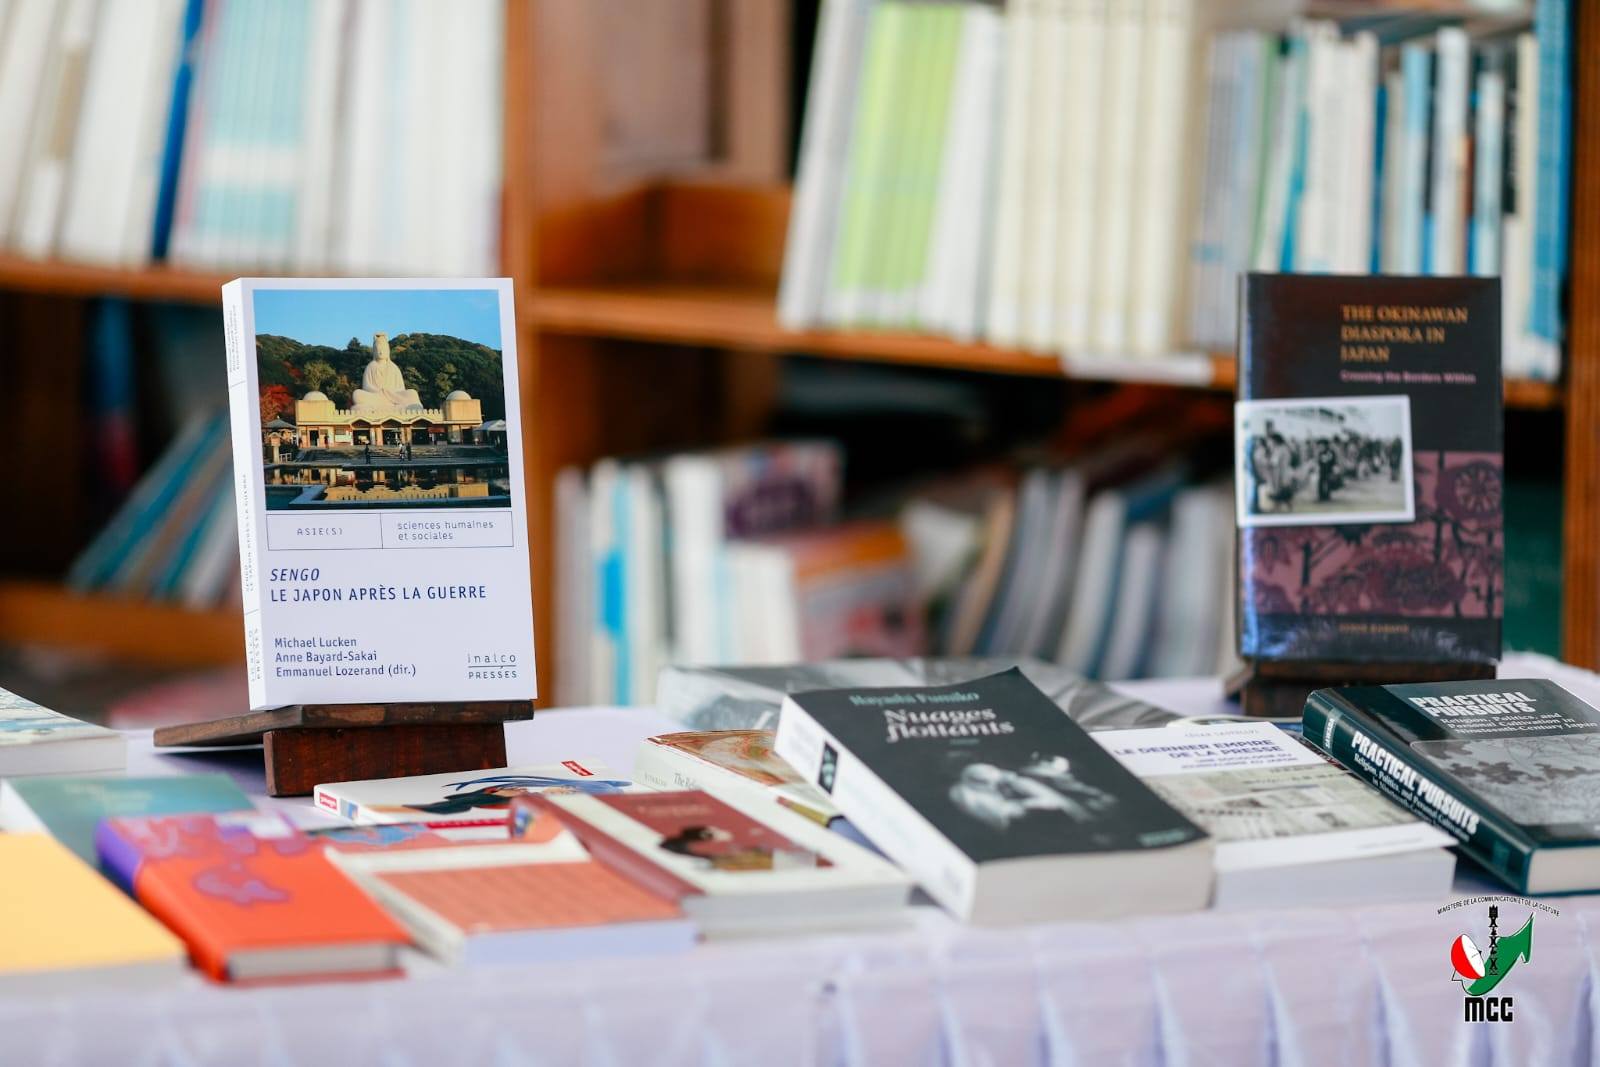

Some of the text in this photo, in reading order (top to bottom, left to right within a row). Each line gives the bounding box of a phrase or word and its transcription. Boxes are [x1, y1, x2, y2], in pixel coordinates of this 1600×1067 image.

[1341, 304, 1468, 323] THE OKINAWAN
[1341, 325, 1445, 343] DIASPORA IN
[1340, 345, 1390, 362] JAPAN
[297, 527, 343, 536] ASIE(S)
[398, 520, 494, 531] sciences humaines
[398, 531, 453, 541] et sociales
[270, 568, 320, 582] SENGO
[271, 584, 487, 602] LE JAPON APRÈS LA GUERRE
[275, 637, 357, 648] Michael Lucken
[275, 650, 377, 665] Anne Bayard-Sakai
[276, 664, 416, 677] Emmanuel Lozerand (dir.)
[468, 670, 517, 679] PRESSES
[1408, 692, 1536, 708] PRACTICAL
[884, 708, 996, 724] Nuages
[1424, 702, 1536, 717] PURSUITS
[1114, 739, 1274, 757] LE DERNIER EMPIRE
[1169, 745, 1282, 759] DE LA PRESSE
[1351, 730, 1479, 835] PRACTICAL PURSUITS
